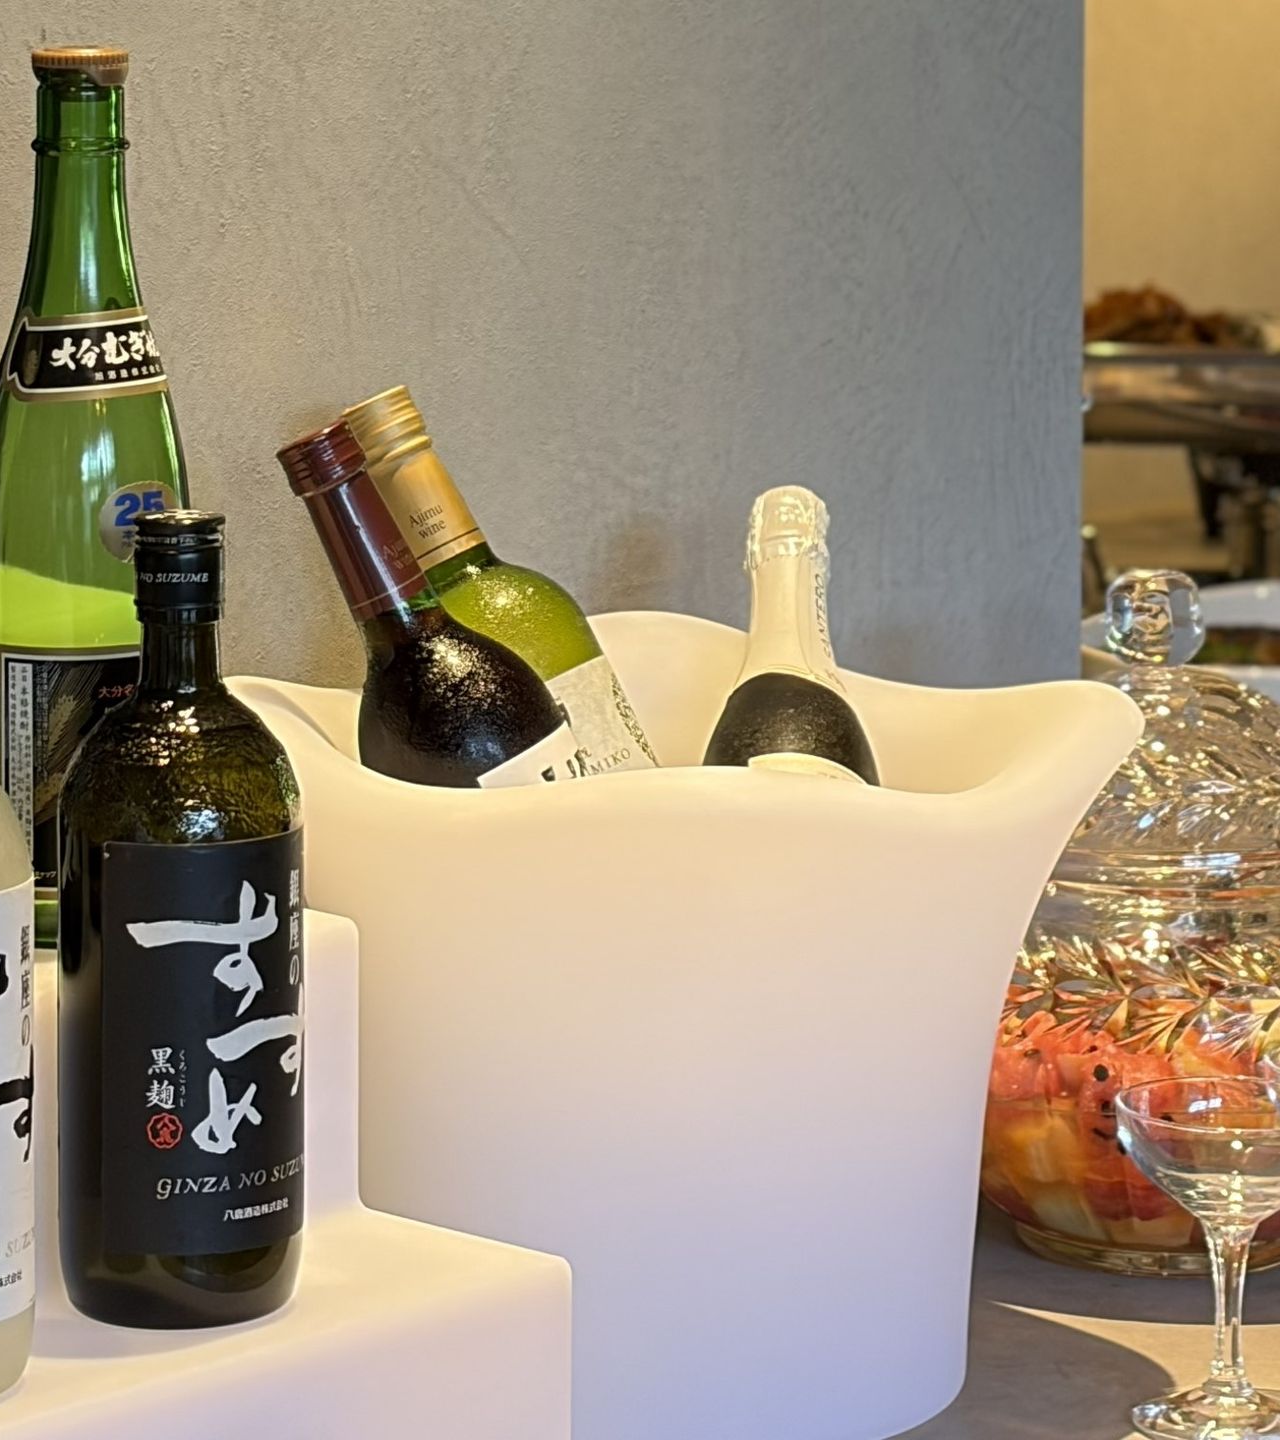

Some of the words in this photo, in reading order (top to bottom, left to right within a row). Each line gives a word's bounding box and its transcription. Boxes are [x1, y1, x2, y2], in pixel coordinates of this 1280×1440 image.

[408, 503, 444, 528] Ajimu
[418, 519, 447, 539] wine
[155, 572, 209, 583] SUZUME
[815, 573, 831, 659] SANTERO
[144, 1046, 177, 1110] 黒麹
[156, 1175, 232, 1201] GINZA
[237, 1168, 267, 1189] NO
